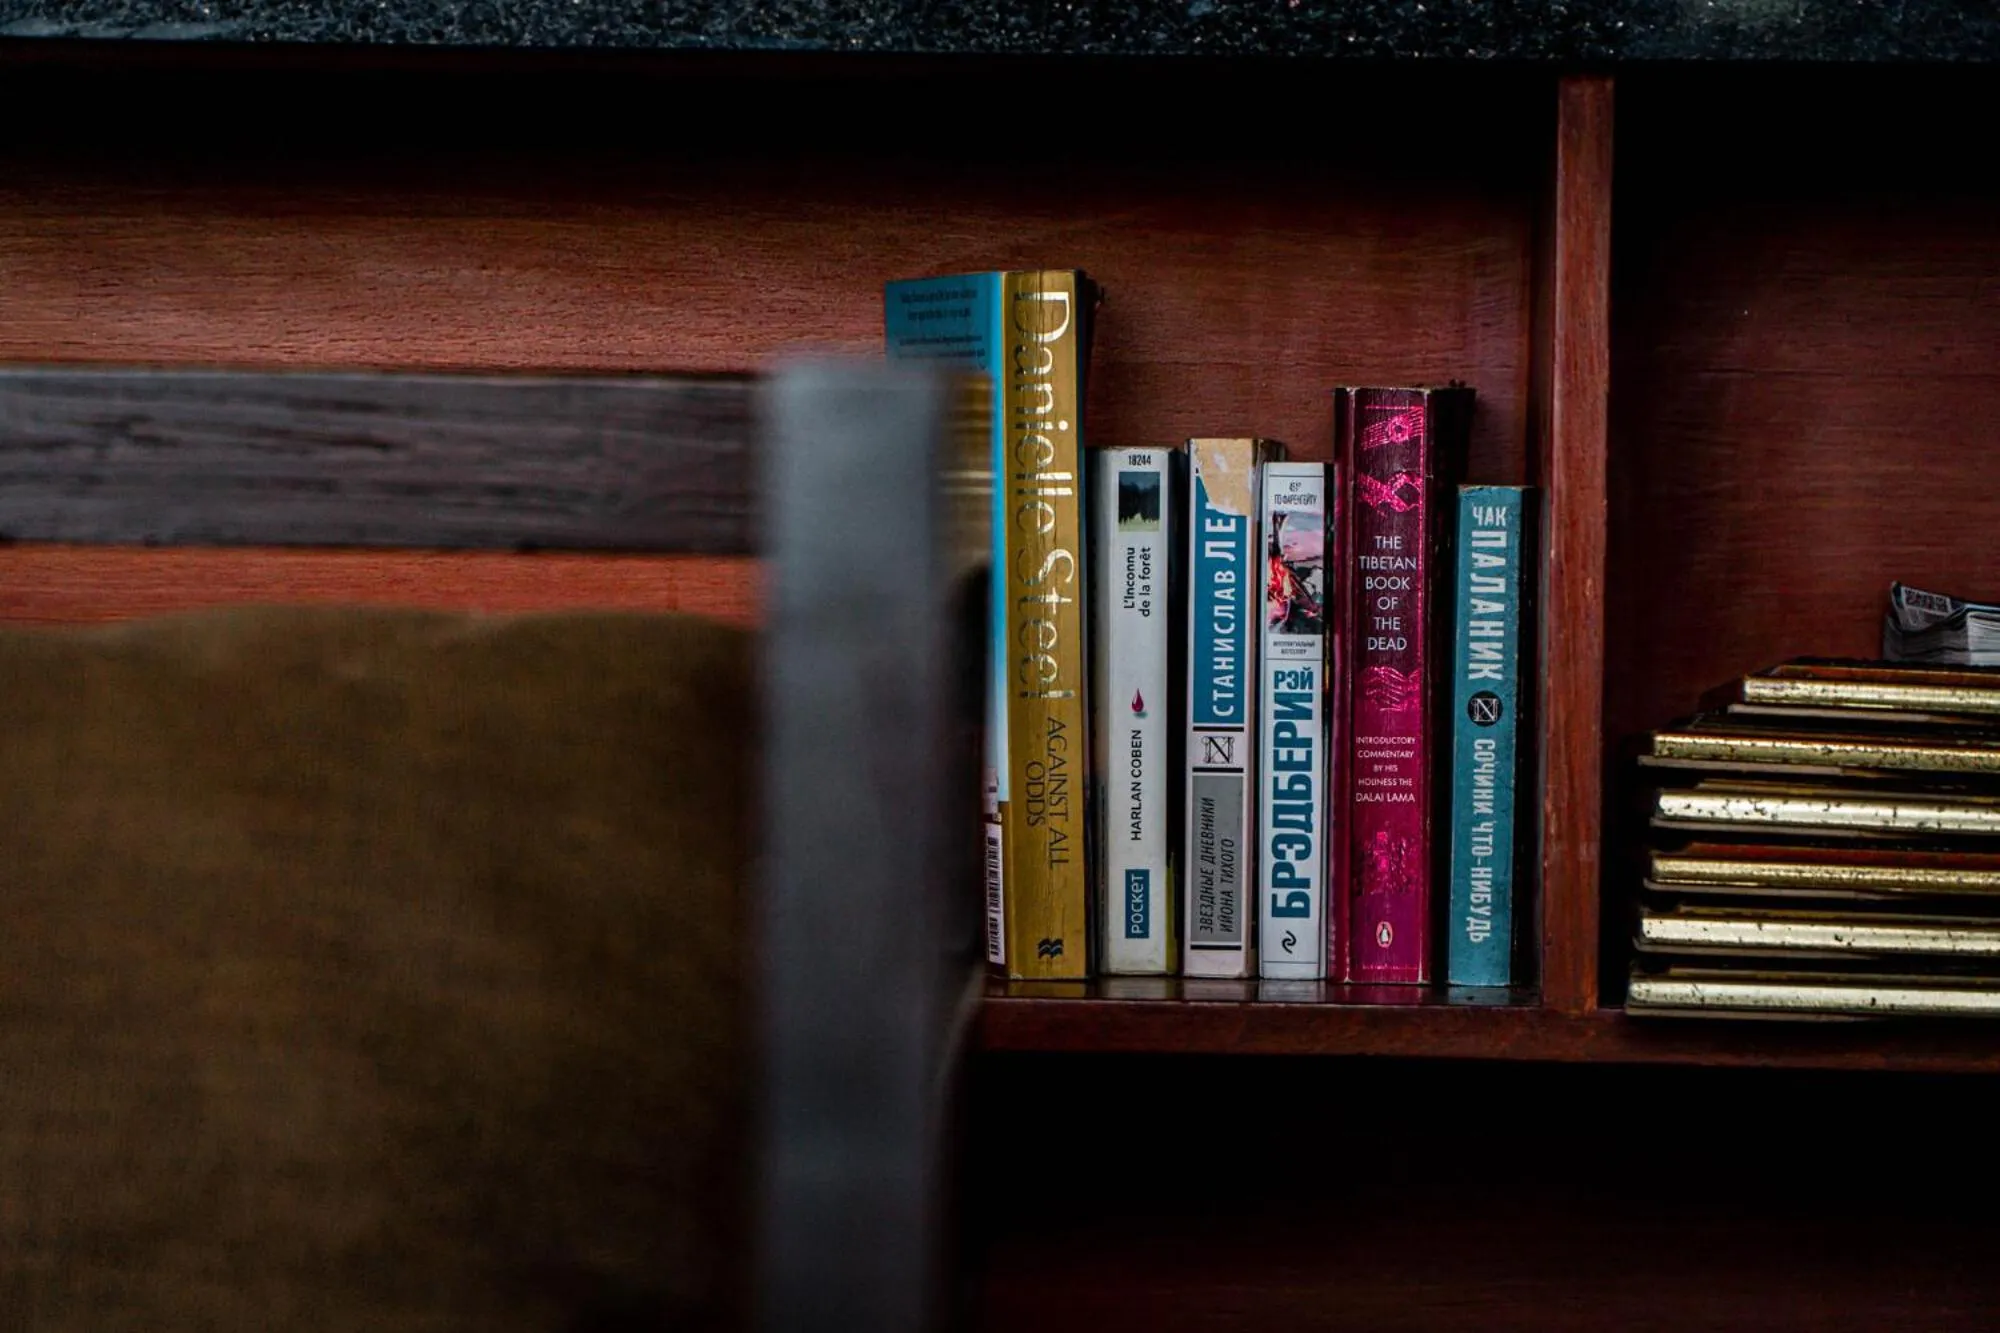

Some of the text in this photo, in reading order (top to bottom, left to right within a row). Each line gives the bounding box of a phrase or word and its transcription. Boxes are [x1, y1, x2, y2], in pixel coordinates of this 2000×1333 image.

[1128, 453, 1152, 467] 18244
[1013, 291, 1076, 700] Danielle Steel
[1472, 505, 1508, 527] ЧАК
[1374, 535, 1402, 550] THE
[1359, 555, 1417, 571] TIBETAN
[1138, 546, 1152, 618] de la forêt
[1365, 576, 1411, 591] BOOK
[1204, 501, 1237, 718] СТАНИСЛАВ ЛЕ
[1376, 596, 1399, 611] OF
[1467, 530, 1508, 681] ПАЛАНИК
[1373, 616, 1402, 631] THE
[1367, 636, 1408, 651] DEAD
[1273, 666, 1315, 690] РЭЙ
[1355, 735, 1417, 746] INTRODUCTORY
[1357, 749, 1414, 759] COMMENTARY
[1373, 763, 1399, 773] BY HIS
[1046, 715, 1070, 870] AGAINST ALL
[1130, 729, 1143, 841] HARLAN COBEN
[1358, 777, 1413, 787] HOLINESS THE
[1025, 760, 1046, 828] ODDS
[1271, 691, 1315, 919] БРЭДБЕРИ
[1355, 792, 1416, 803] DALAI LAMA
[1465, 738, 1498, 943] СОЧИНИ ЧТО-НИБУДЬ
[1200, 796, 1216, 934] ЗВЕЗДНЫЕ ДНЕВНИКИ
[1217, 838, 1235, 933] ИЙОНА ТИХОГО
